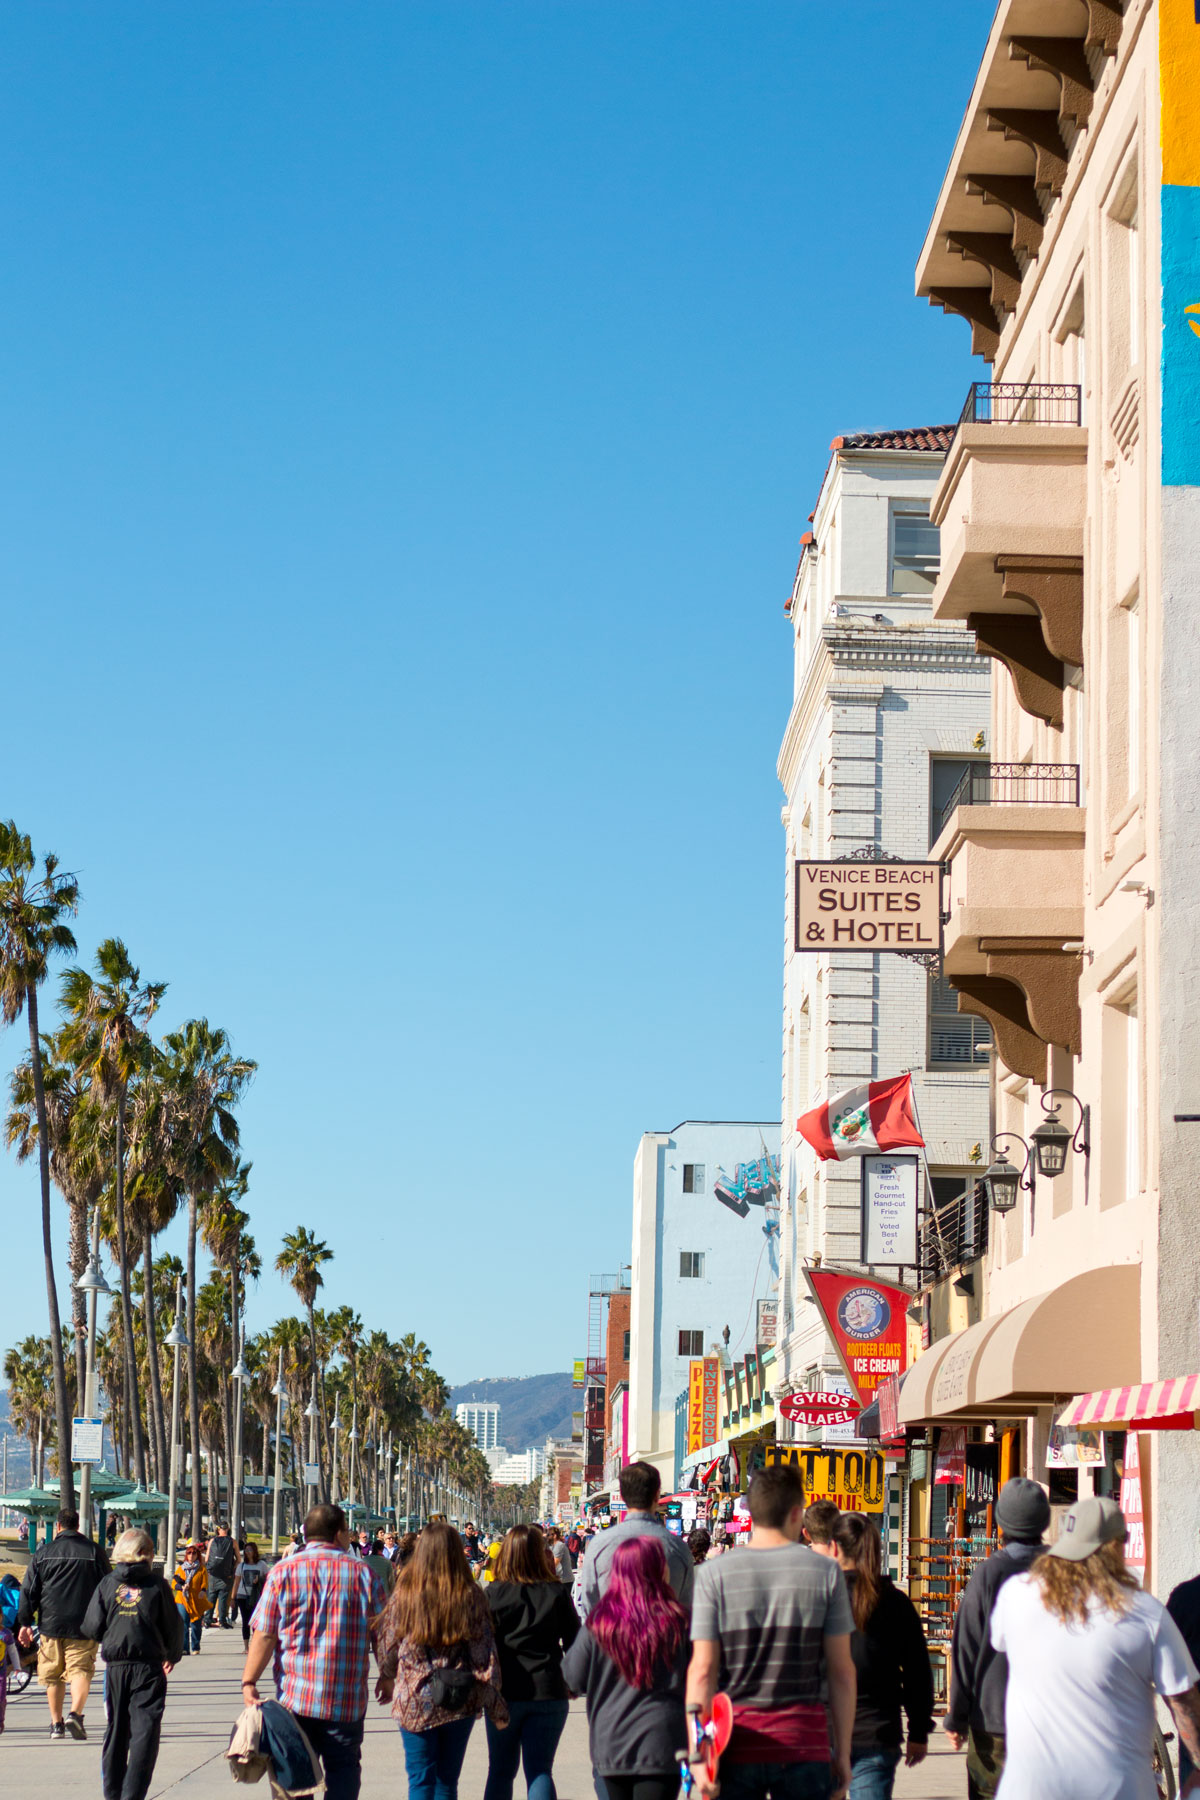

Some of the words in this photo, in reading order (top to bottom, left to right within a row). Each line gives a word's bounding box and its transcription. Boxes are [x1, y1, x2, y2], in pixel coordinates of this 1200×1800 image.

[806, 868, 870, 883] VENICE
[875, 868, 934, 883] BEACH
[818, 888, 921, 912] SUITES
[806, 921, 825, 941] &
[833, 919, 932, 942] HOTEL
[845, 1288, 885, 1305] AMERICAN
[845, 1326, 881, 1339] BURGER
[846, 1342, 878, 1356] ROOTBEER
[879, 1343, 902, 1356] FLOATS
[853, 1358, 868, 1372] ICE
[869, 1358, 900, 1373] CREAM
[858, 1374, 876, 1389] MILK
[704, 1363, 717, 1443] INDIGENOUS
[792, 1392, 850, 1408] GYROS
[691, 1367, 703, 1452] PIZZA
[788, 1408, 853, 1424] FALAFEL
